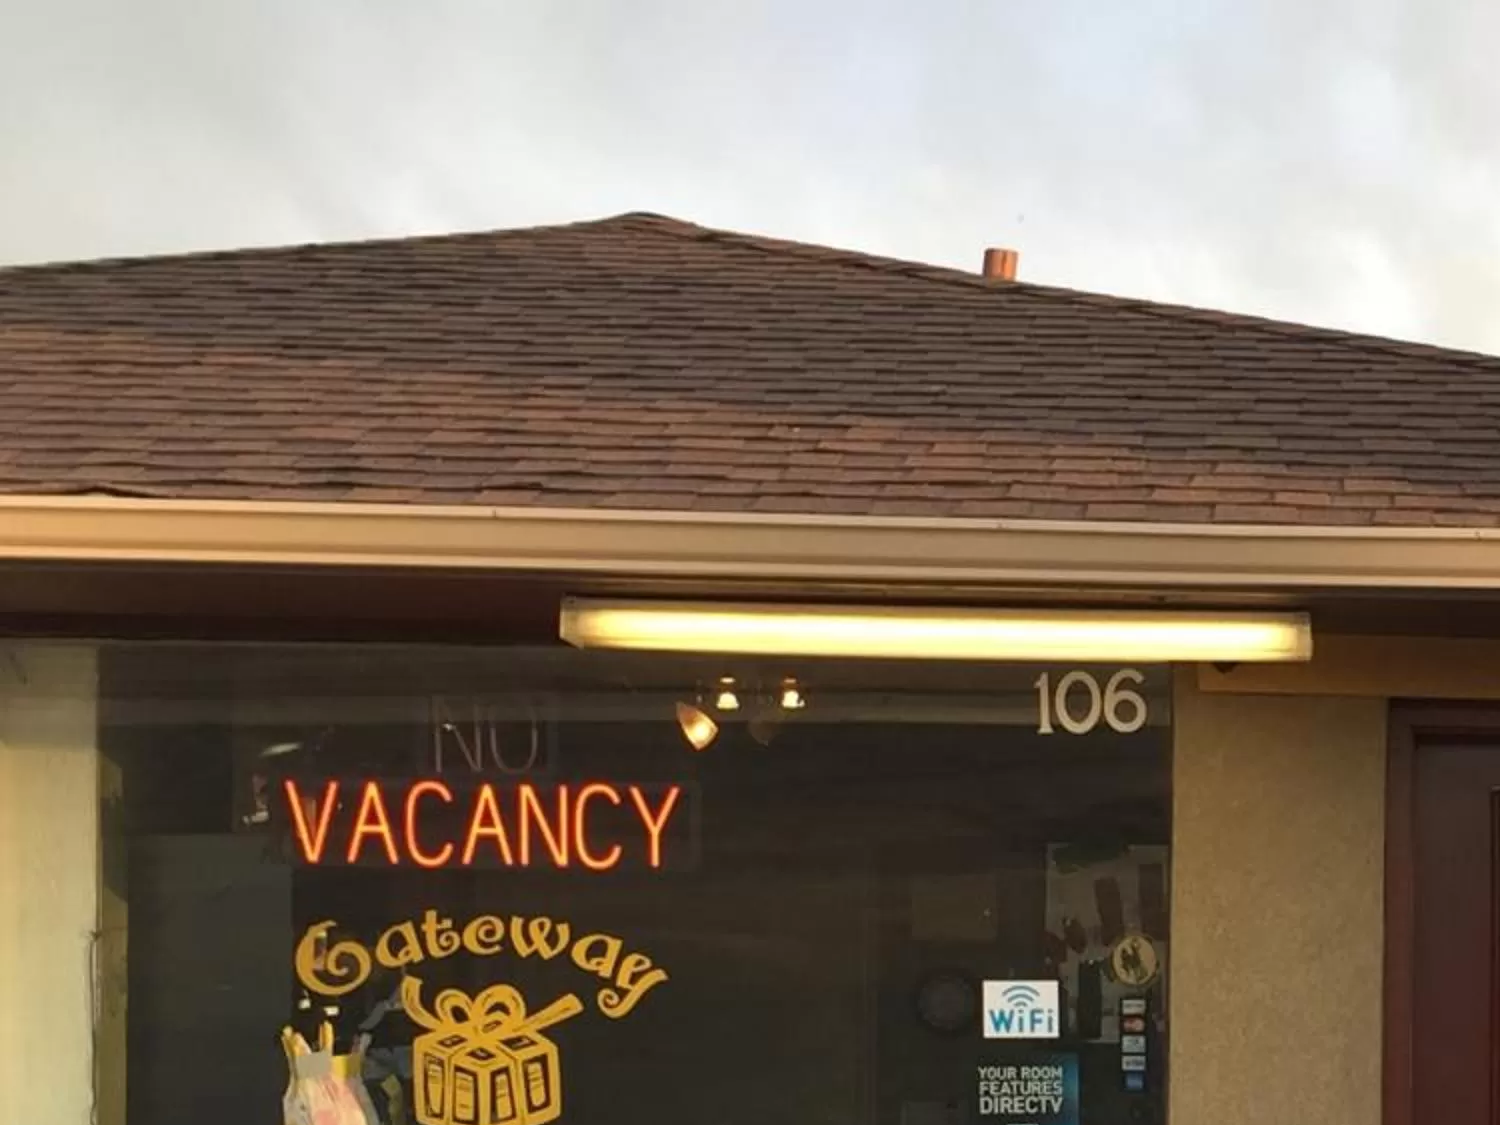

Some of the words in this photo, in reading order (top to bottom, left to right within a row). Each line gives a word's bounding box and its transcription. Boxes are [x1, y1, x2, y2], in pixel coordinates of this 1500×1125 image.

[1034, 669, 1147, 735] 106
[432, 697, 538, 774] NO
[285, 779, 680, 870] VACANCY
[295, 908, 669, 1019] Gateway
[989, 1008, 1054, 1034] WiFi
[978, 1066, 1017, 1079] YOUR
[1021, 1066, 1063, 1079] ROOM
[979, 1081, 1062, 1095] FEATURES
[979, 1097, 1063, 1115] DIRECTV
